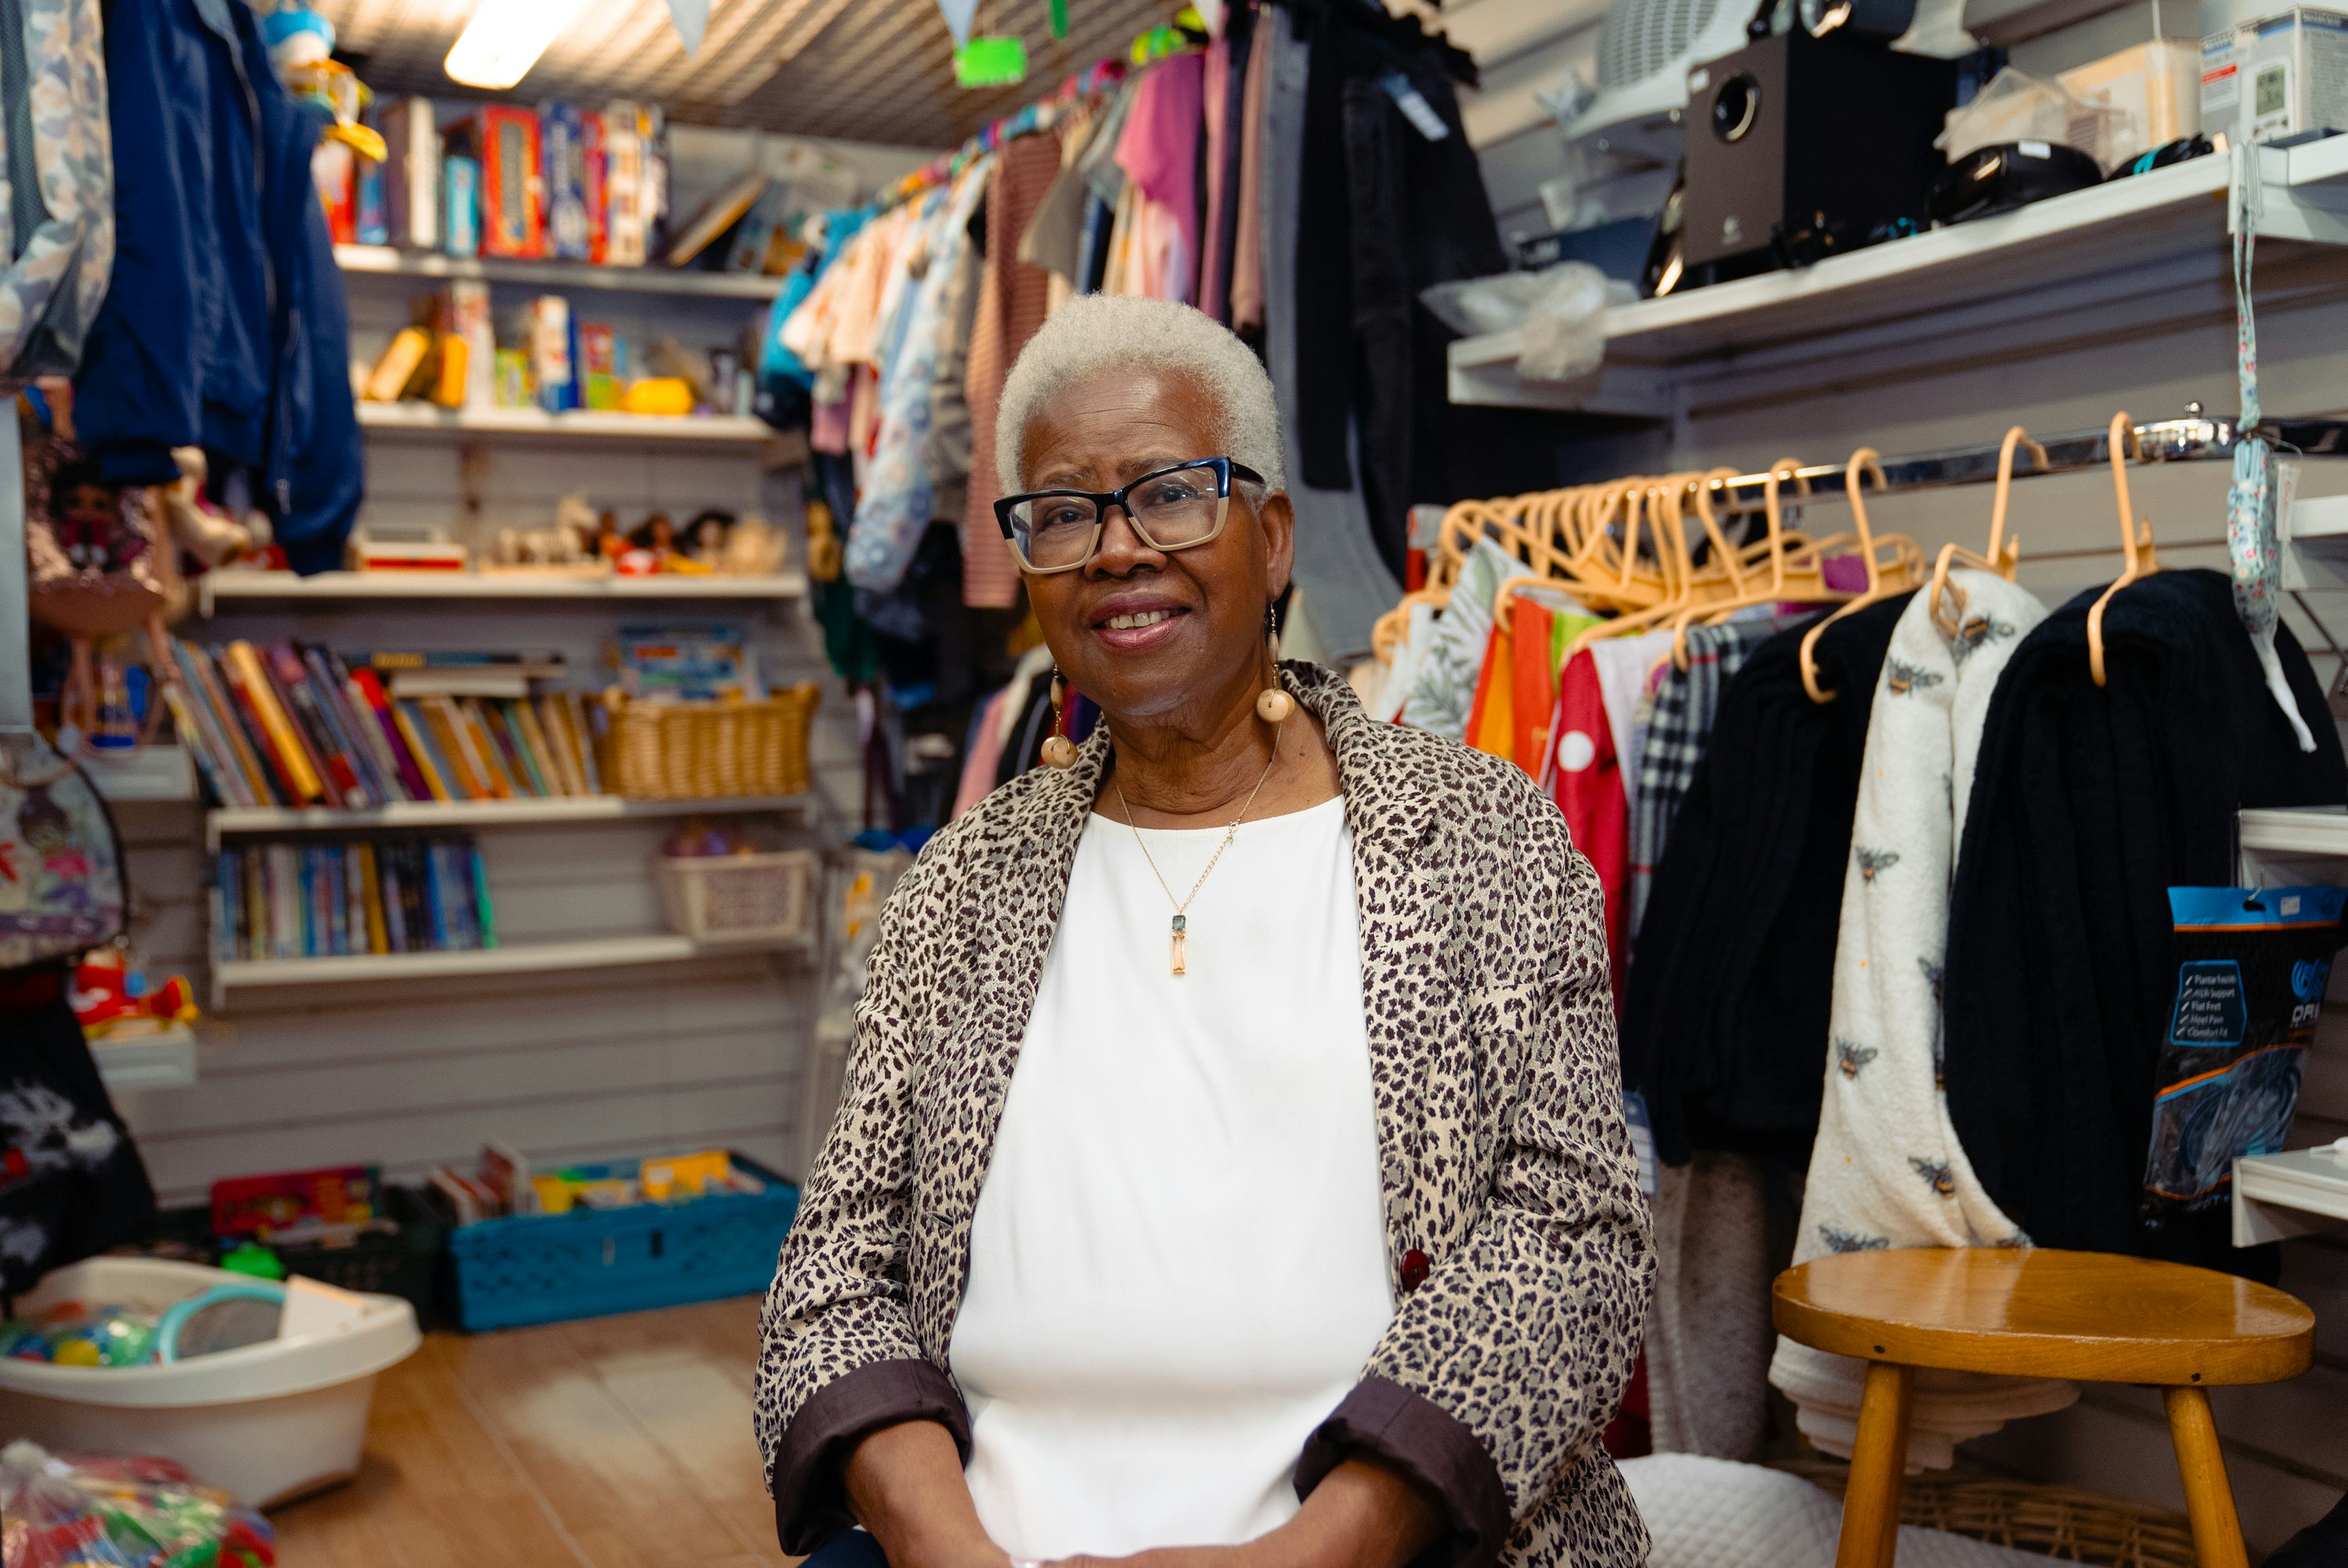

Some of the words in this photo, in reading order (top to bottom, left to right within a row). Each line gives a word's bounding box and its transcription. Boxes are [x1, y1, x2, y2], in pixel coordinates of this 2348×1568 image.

[2210, 988, 2235, 999] Support
[2191, 1001, 2206, 1012] Flat
[2206, 1001, 2221, 1012] Feet
[2190, 1014, 2208, 1025] Heel
[2209, 1014, 2224, 1025] Pain
[2187, 1027, 2218, 1038] Comfort
[2219, 1028, 2229, 1038] Fit
